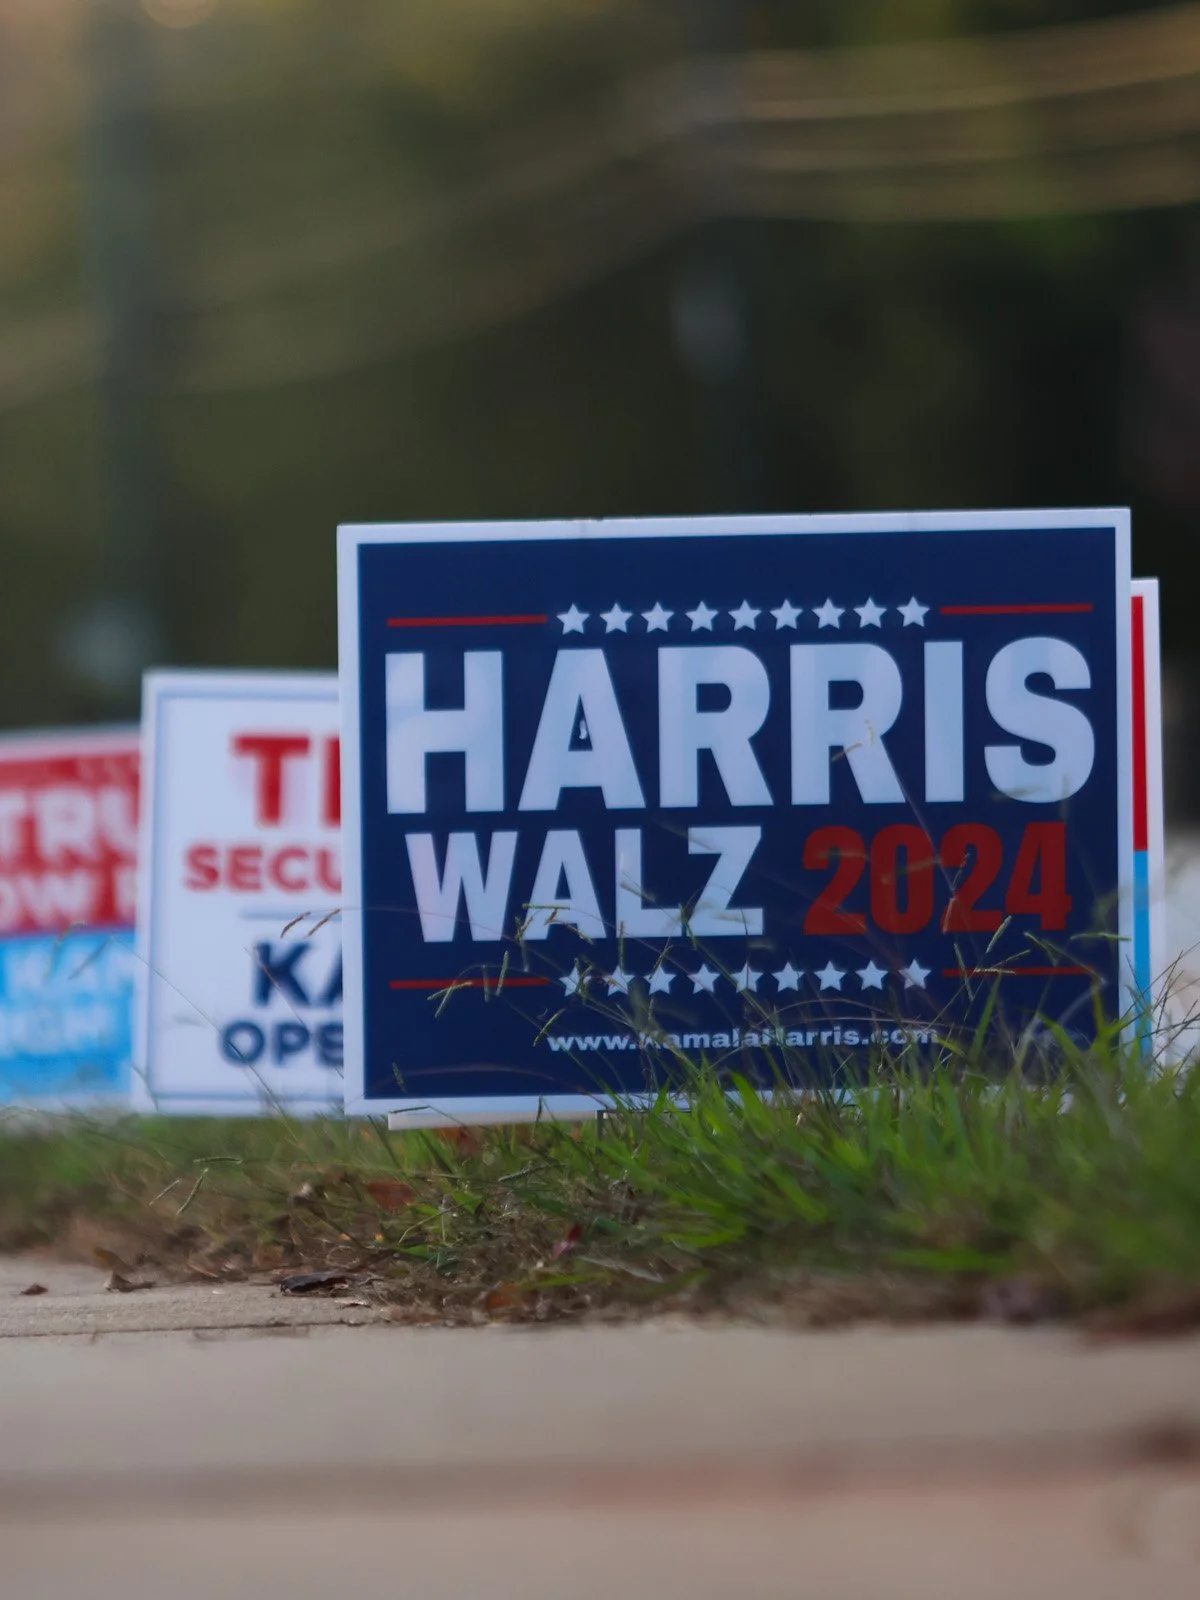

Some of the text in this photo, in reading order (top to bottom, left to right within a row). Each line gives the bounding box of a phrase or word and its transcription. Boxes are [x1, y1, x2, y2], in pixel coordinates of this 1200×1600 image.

[385, 636, 1095, 814] HARRIS
[404, 822, 1072, 943] WALZ 2024
